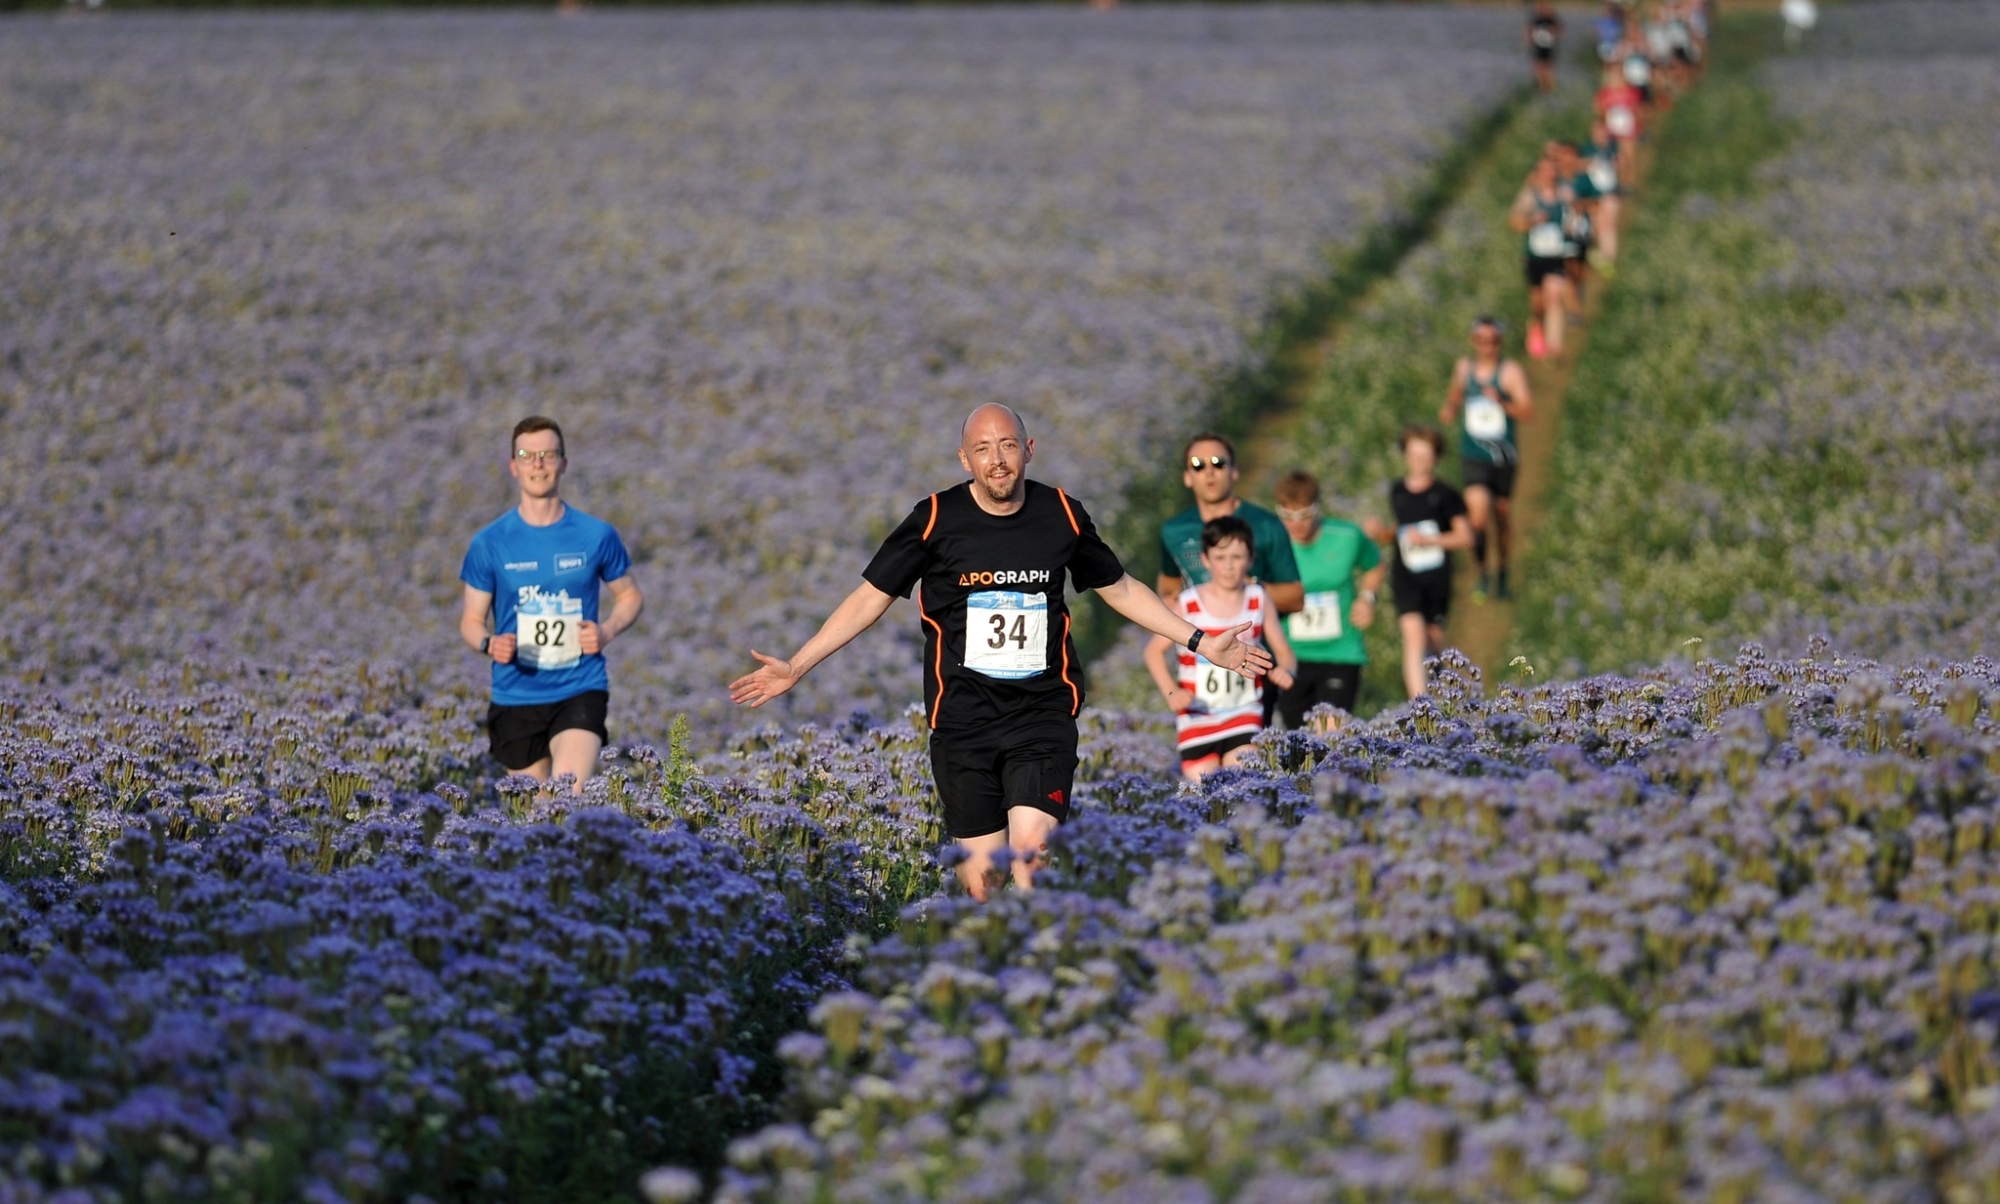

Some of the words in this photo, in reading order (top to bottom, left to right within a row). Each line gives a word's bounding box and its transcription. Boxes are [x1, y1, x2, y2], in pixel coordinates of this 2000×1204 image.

[958, 570, 1050, 586] APOGRAPH
[518, 584, 541, 605] 5K
[535, 620, 565, 646] 82
[987, 613, 1028, 650] 34
[1206, 669, 1246, 694] 614
